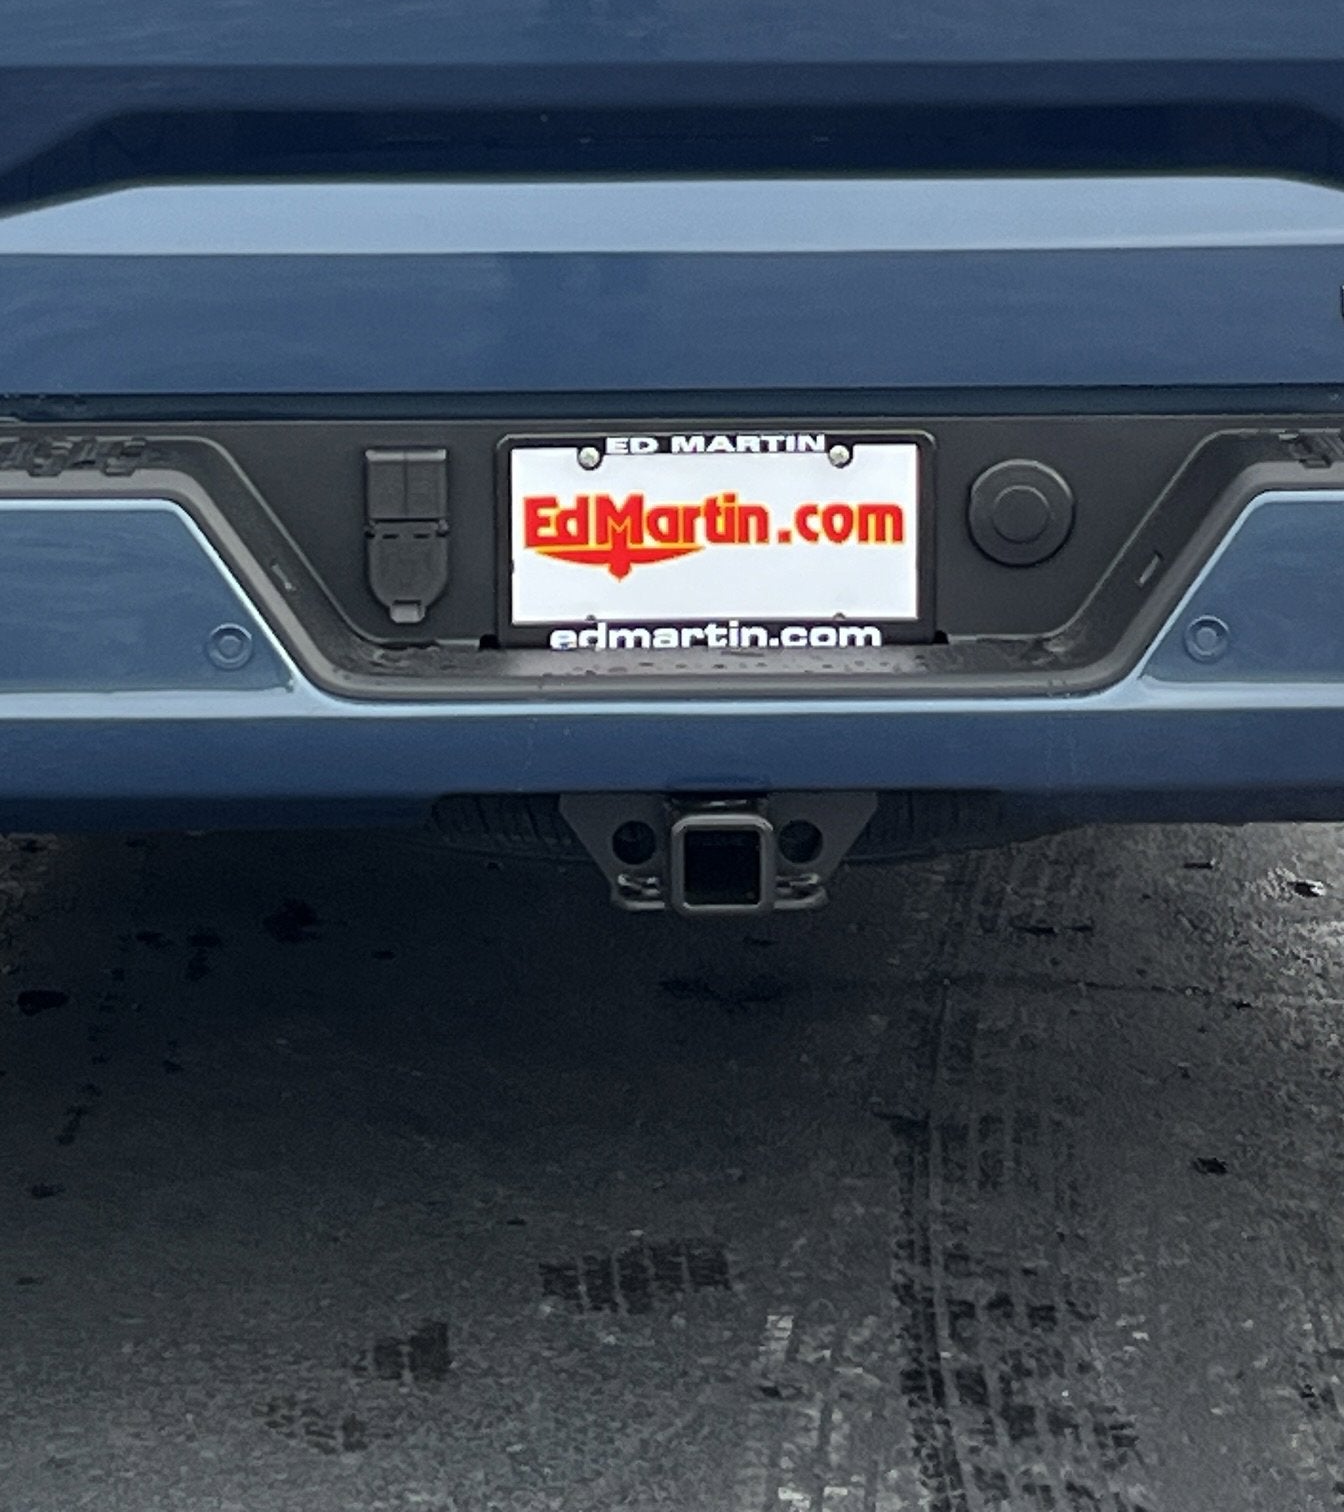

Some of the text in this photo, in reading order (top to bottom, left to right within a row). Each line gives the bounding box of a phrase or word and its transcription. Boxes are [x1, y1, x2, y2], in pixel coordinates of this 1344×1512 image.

[605, 434, 826, 455] ED MARTIN
[523, 491, 905, 550] EdMartin.com
[549, 620, 883, 651] edmartin.com
